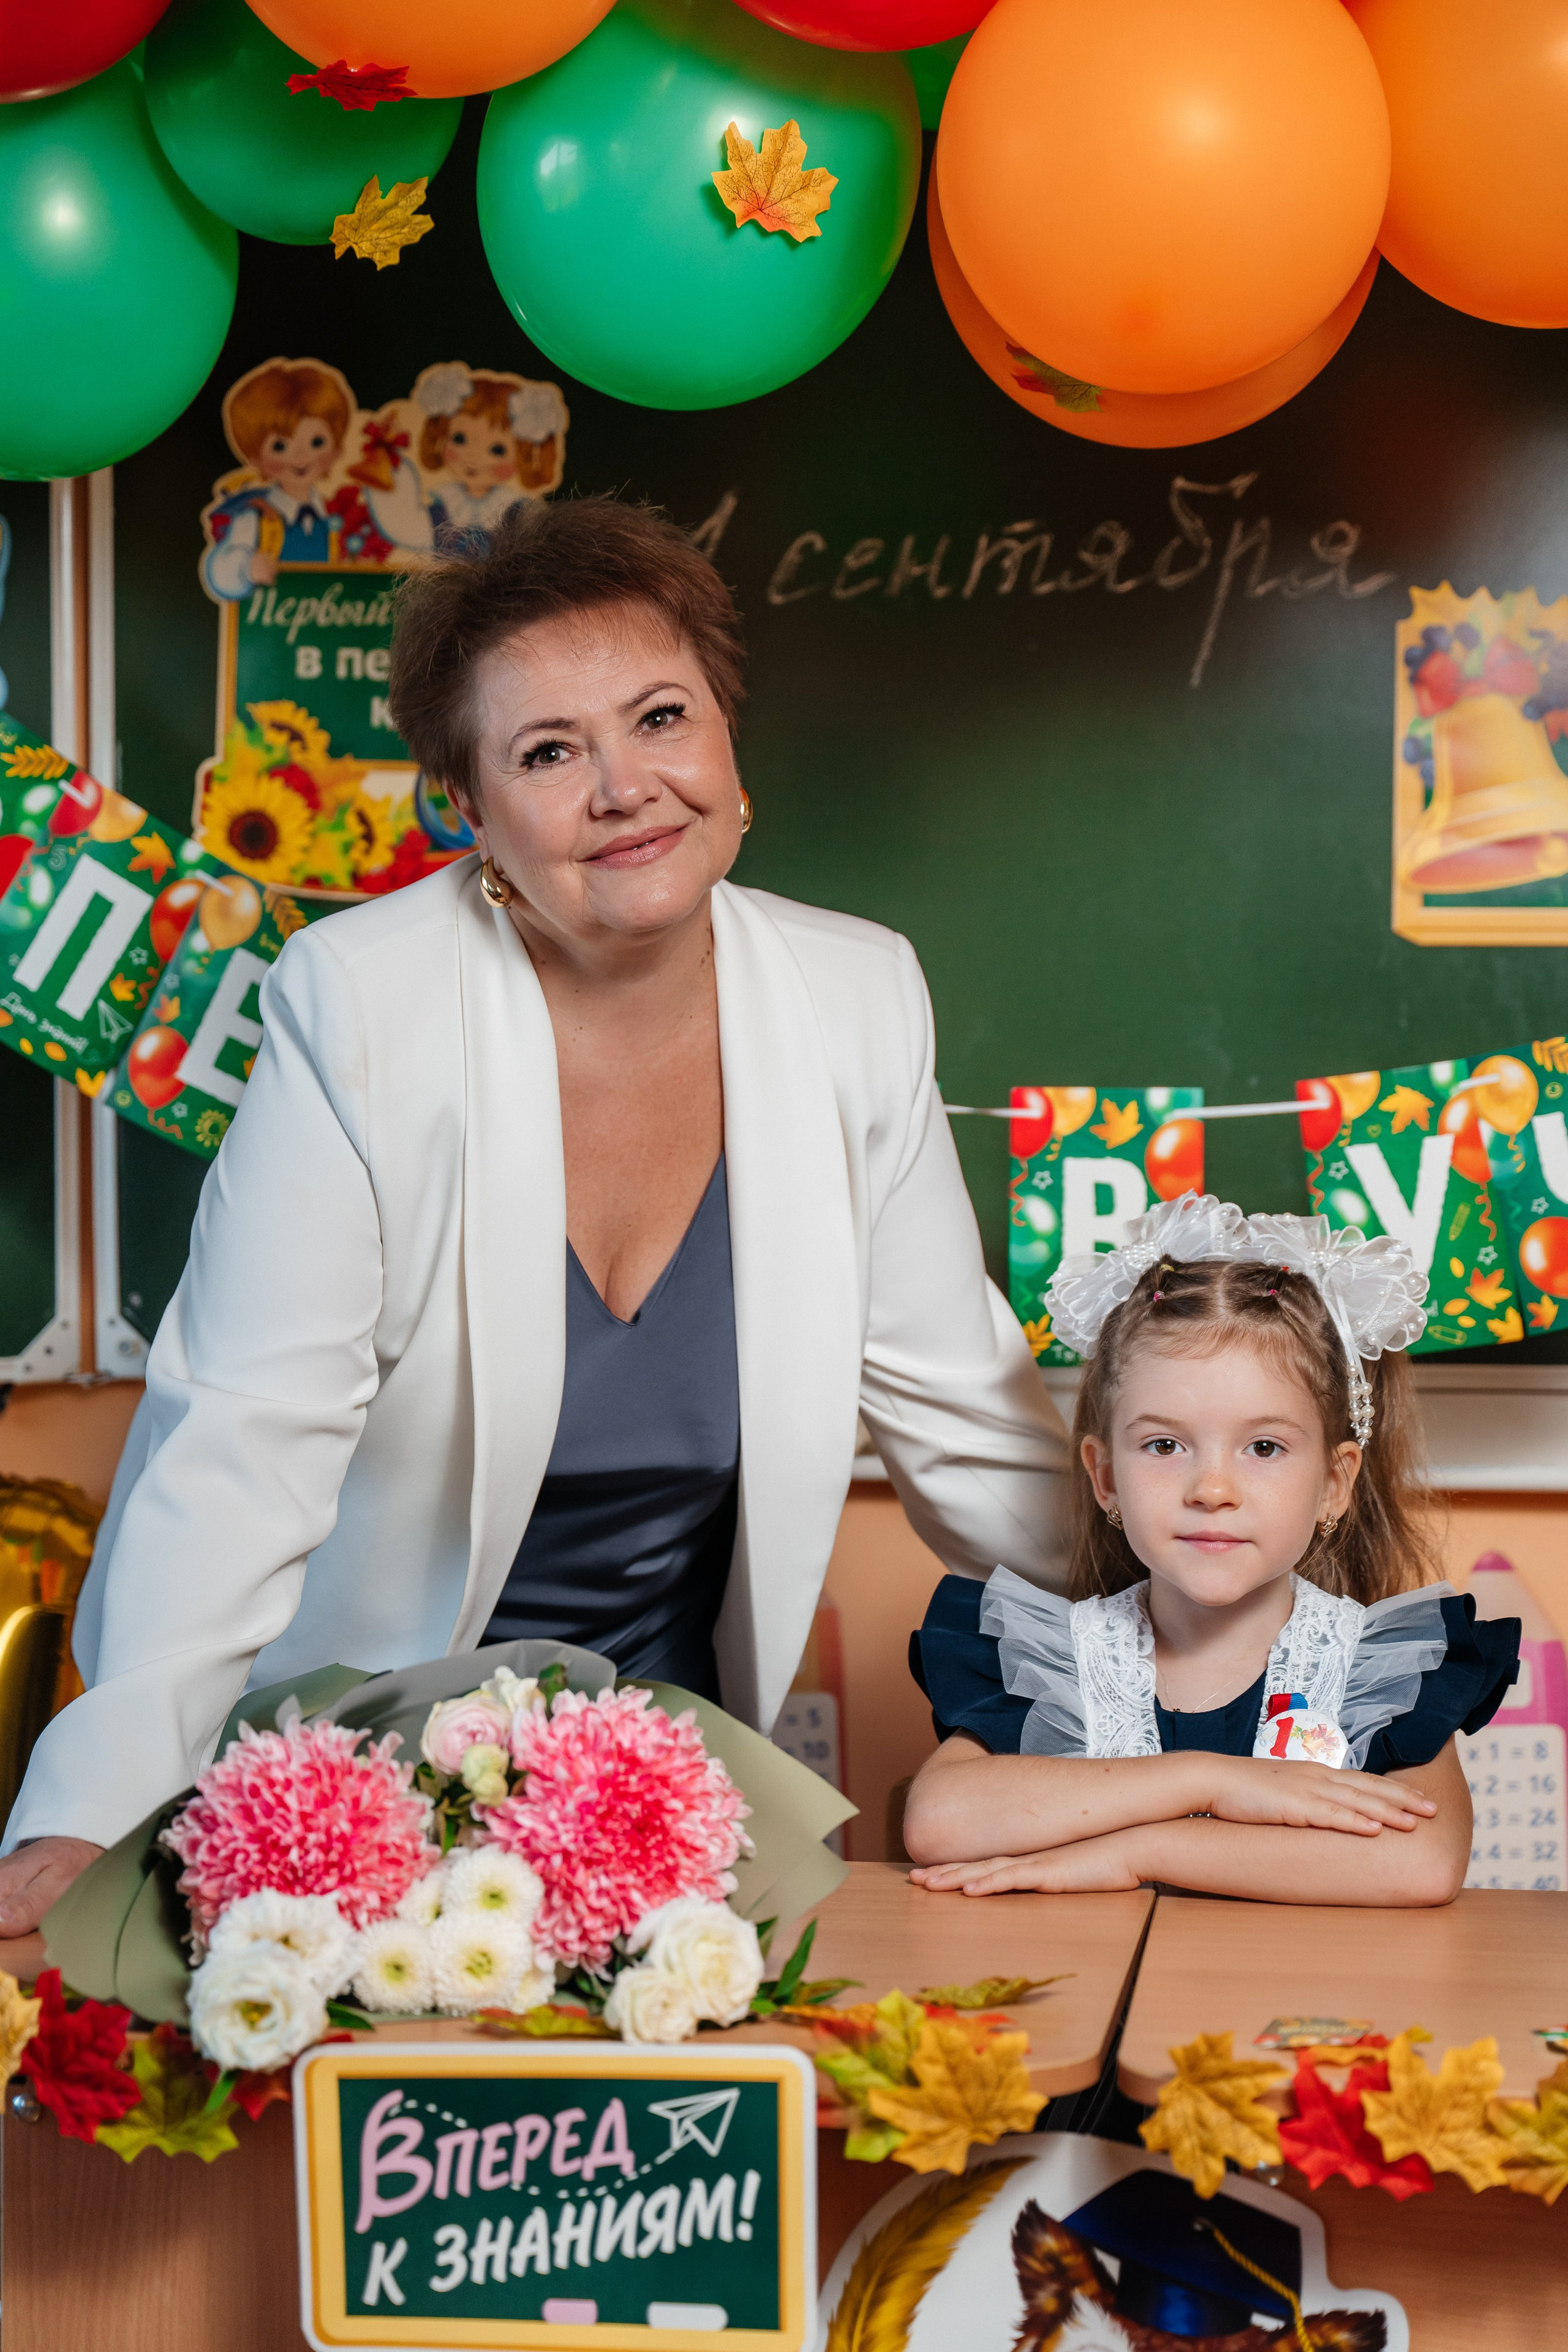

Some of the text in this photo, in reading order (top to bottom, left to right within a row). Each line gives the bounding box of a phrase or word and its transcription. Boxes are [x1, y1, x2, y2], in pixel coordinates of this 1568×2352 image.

[766, 472, 1398, 688] сентября
[1535, 1740, 1548, 1762] 8
[1529, 1773, 1556, 1795] 16
[1529, 1807, 1557, 1828] 24
[1531, 1840, 1558, 1861] 32
[429, 2168, 761, 2293] ЗНАНИЯМ!
